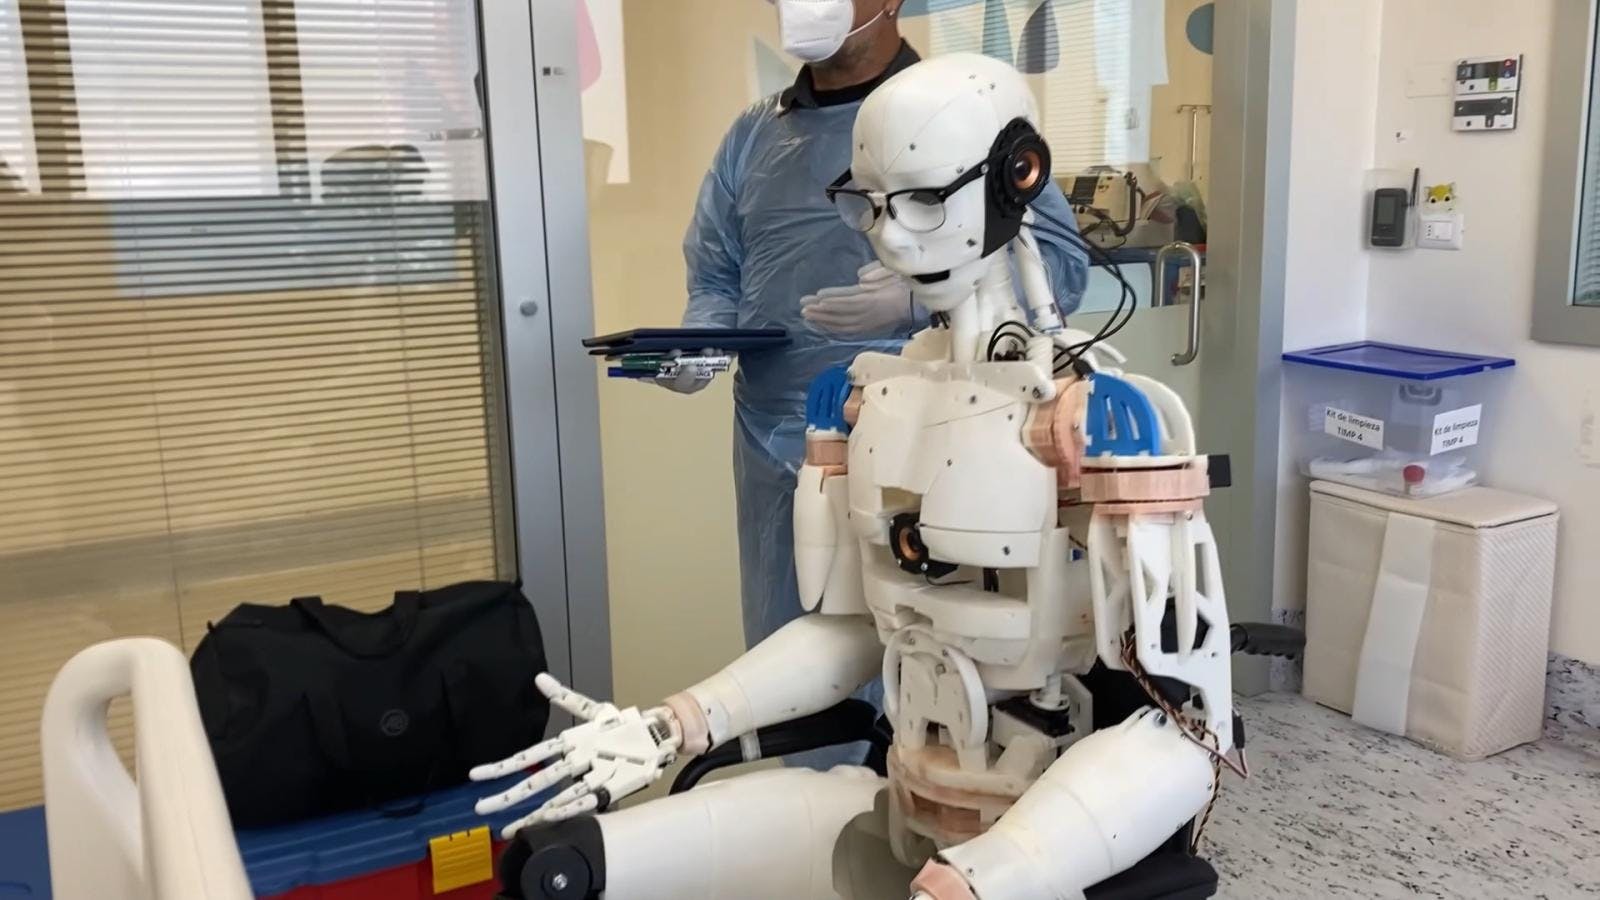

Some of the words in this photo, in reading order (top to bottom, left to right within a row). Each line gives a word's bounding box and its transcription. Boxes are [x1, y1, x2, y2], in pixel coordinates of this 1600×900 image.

[1327, 409, 1336, 419] Kit
[1338, 413, 1347, 421] de
[1350, 415, 1380, 431] limpieza
[1337, 426, 1356, 438] TIMP
[1357, 433, 1363, 441] 4
[1434, 427, 1442, 435] Kit
[1443, 423, 1451, 434] de
